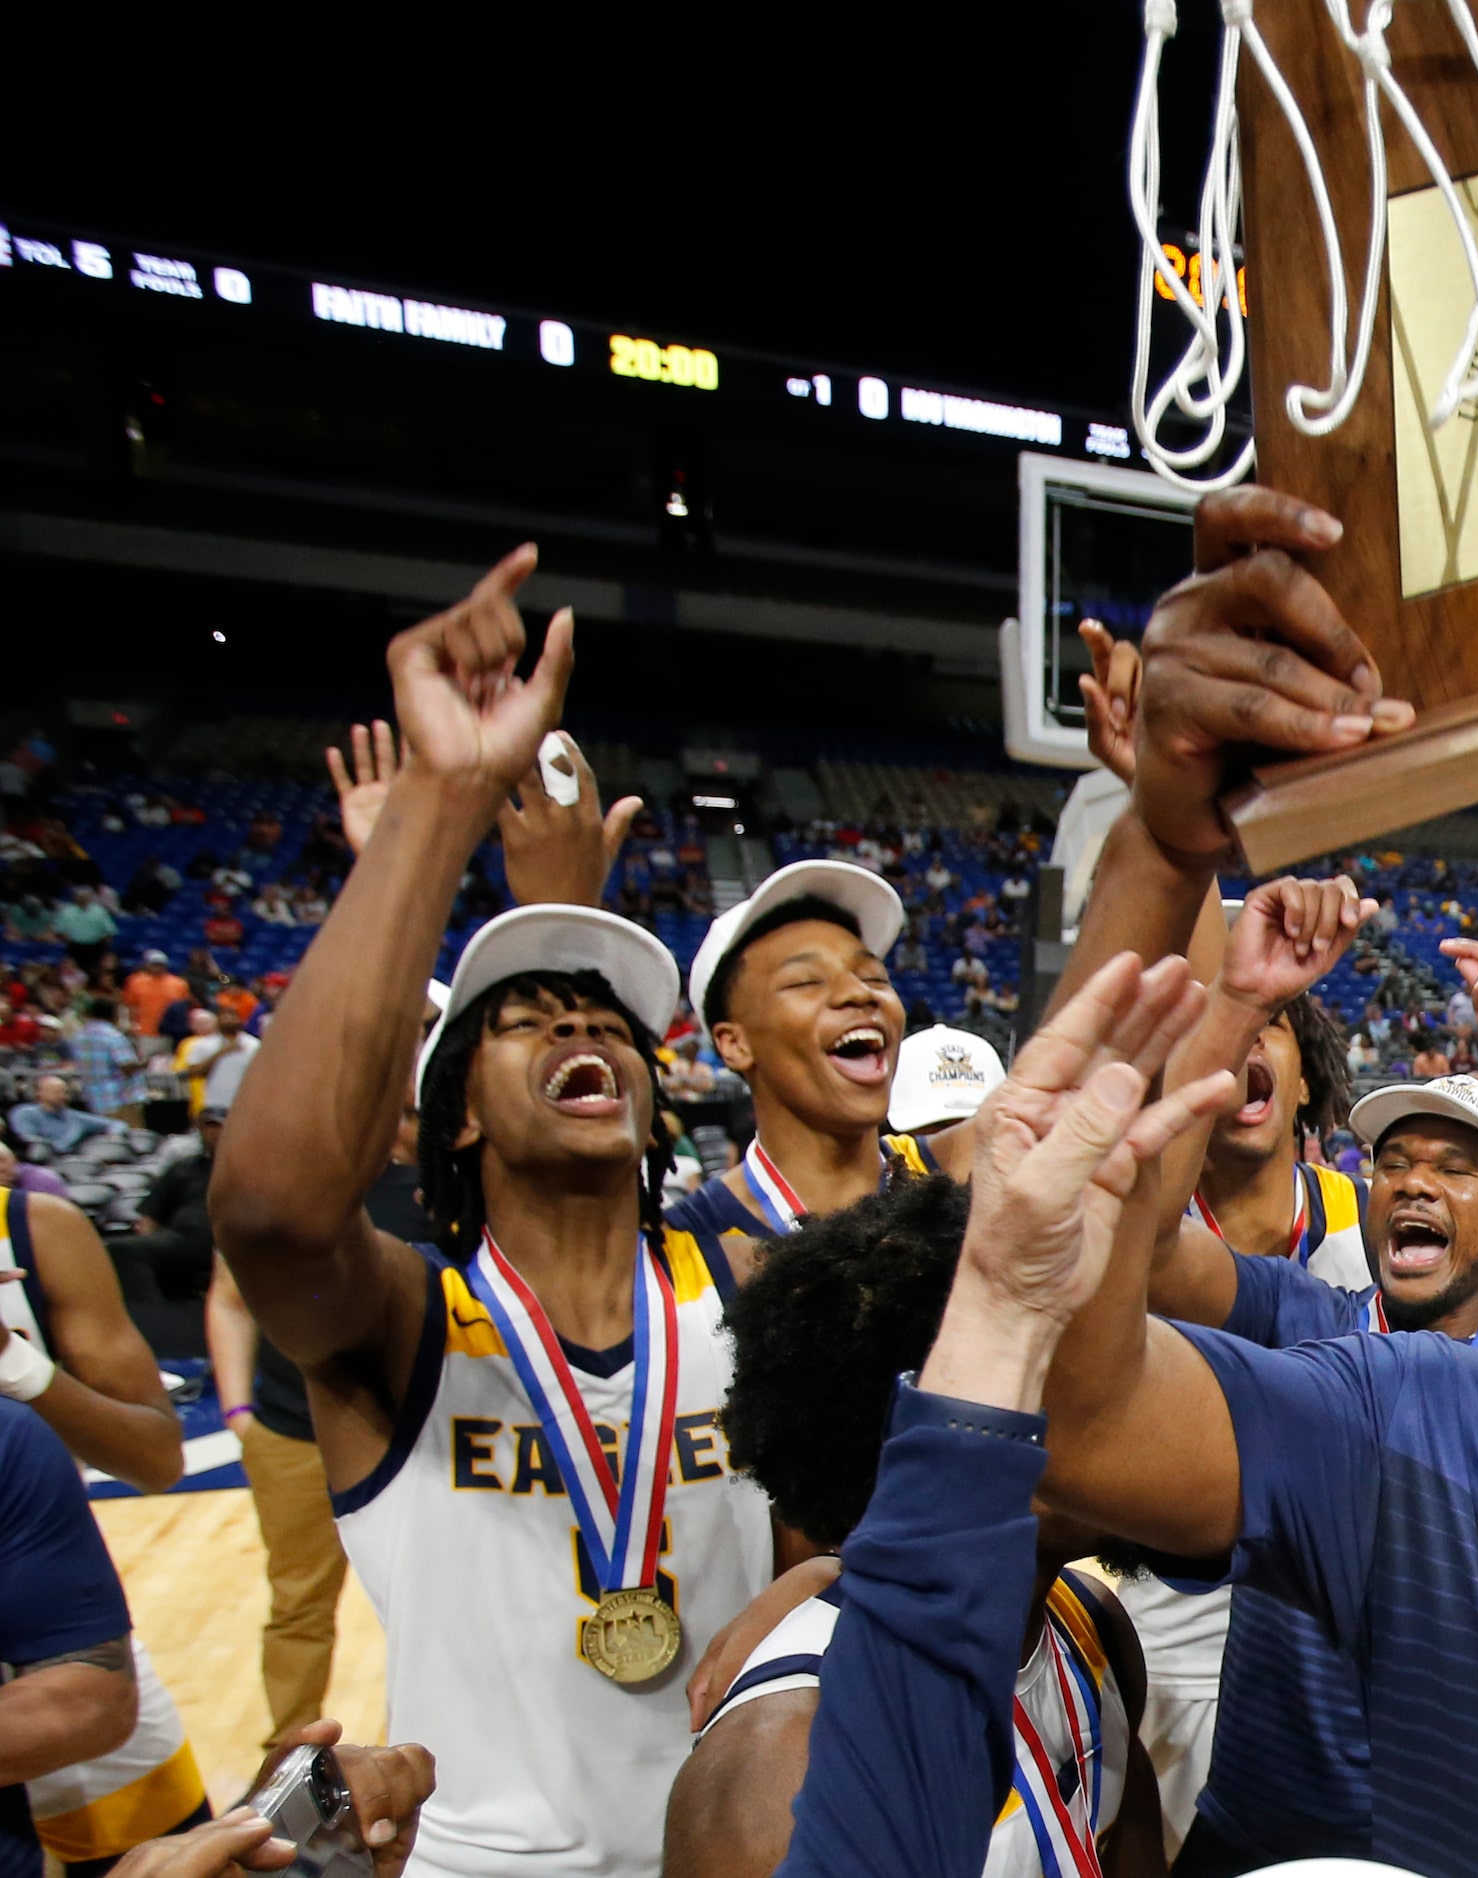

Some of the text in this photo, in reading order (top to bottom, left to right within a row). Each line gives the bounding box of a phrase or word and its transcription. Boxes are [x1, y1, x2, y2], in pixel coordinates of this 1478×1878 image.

[71, 238, 113, 279] 5
[213, 265, 252, 304] 0
[312, 283, 506, 350] FAITH FAMILY
[539, 319, 574, 366] 0
[609, 334, 719, 391] 20:00
[858, 376, 889, 420] 0
[929, 1070, 985, 1083] CHAMPIONS
[449, 1408, 741, 1497] EAGE
